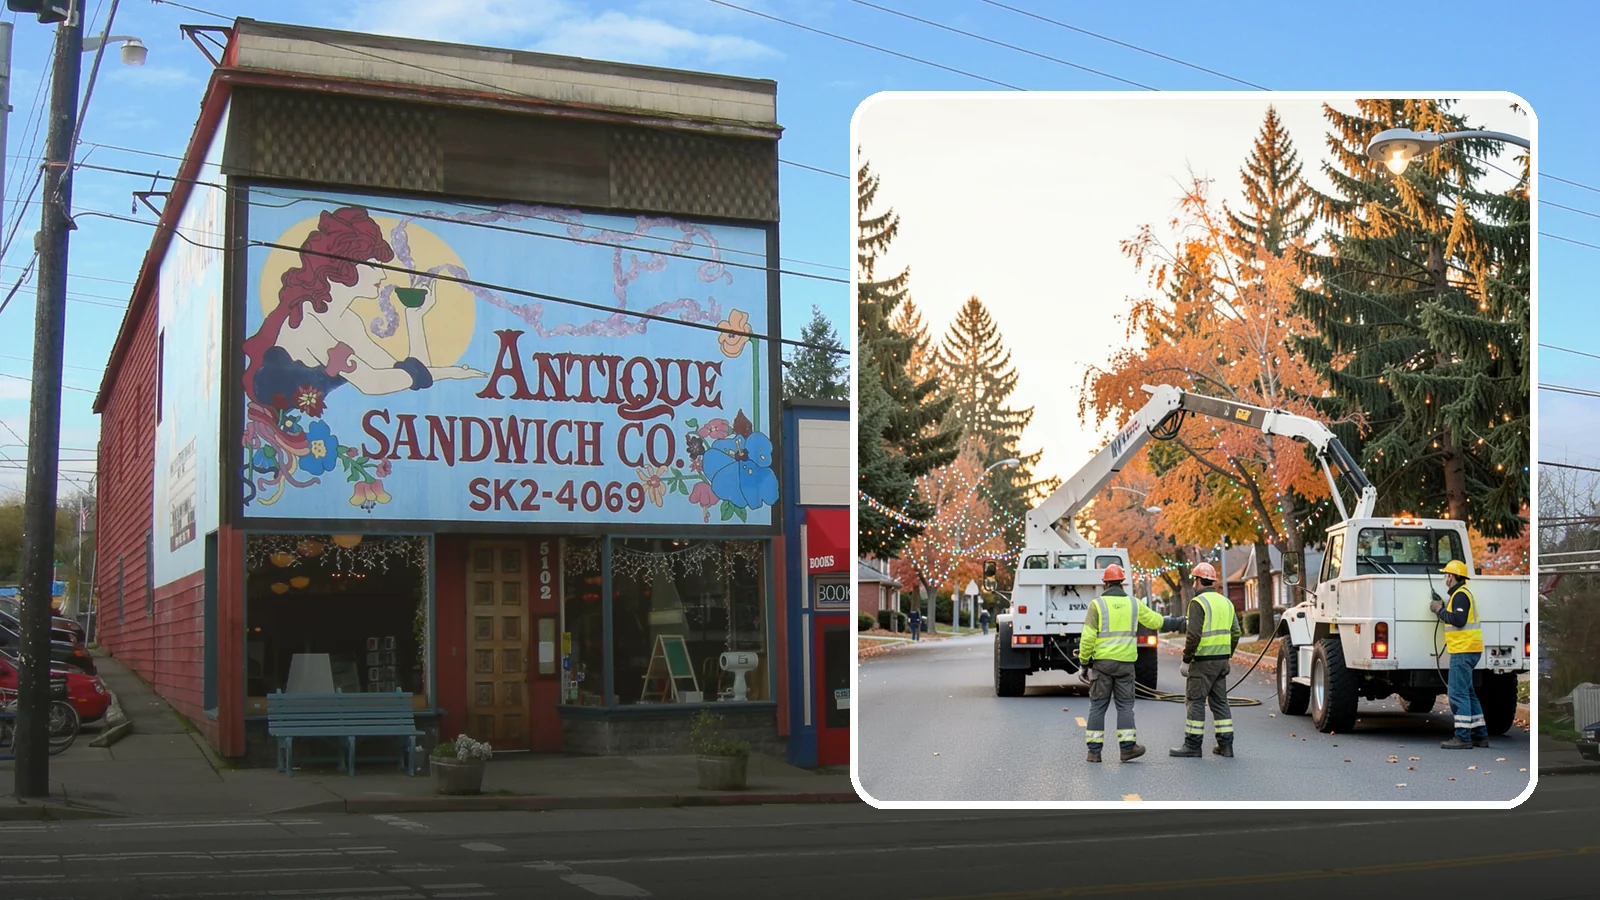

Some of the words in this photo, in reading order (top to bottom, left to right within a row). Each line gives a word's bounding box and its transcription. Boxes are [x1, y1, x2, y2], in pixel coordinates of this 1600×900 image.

[477, 329, 723, 420] ANTIQUE
[361, 409, 604, 468] SANDWICH
[617, 423, 686, 469] CO.
[468, 477, 646, 513] SK2-4069
[539, 541, 552, 599] 5102
[809, 555, 835, 569] BOOKS
